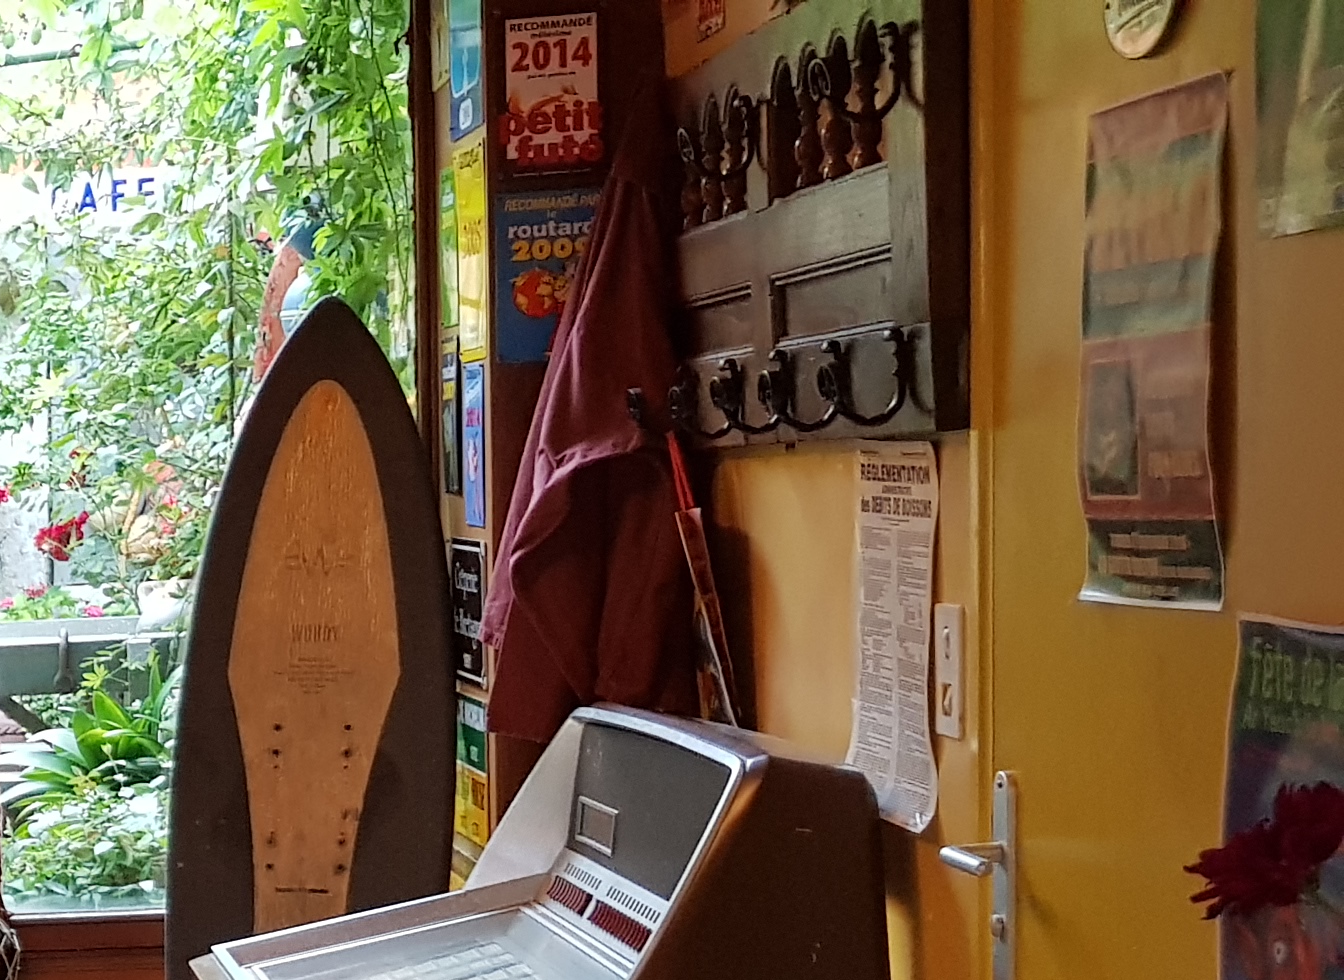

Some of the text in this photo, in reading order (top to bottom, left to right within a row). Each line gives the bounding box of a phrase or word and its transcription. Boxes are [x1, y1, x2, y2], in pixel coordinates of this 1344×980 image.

[509, 16, 593, 33] RECOMMANDÉ
[511, 36, 593, 73] 2014
[499, 99, 603, 146] petit
